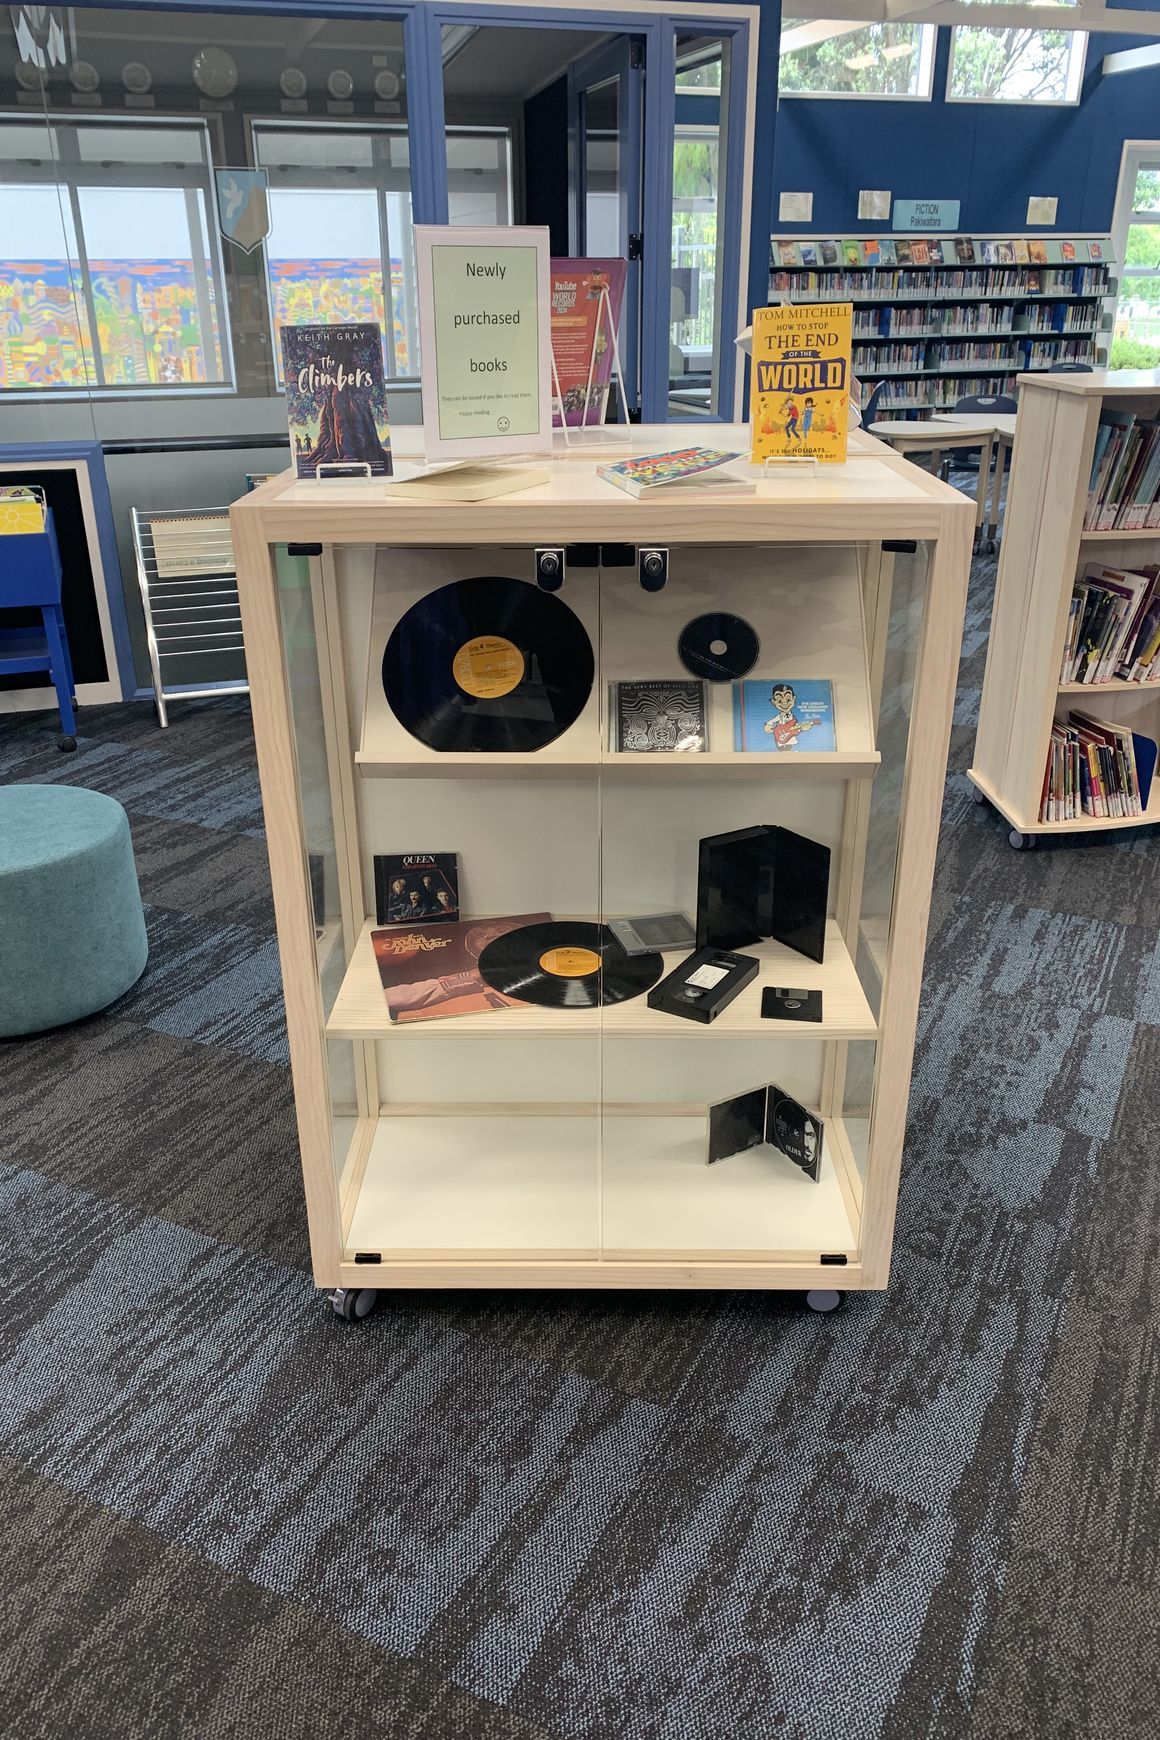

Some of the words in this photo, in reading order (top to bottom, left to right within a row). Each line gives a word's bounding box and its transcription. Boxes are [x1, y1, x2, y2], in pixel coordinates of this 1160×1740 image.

[915, 203, 939, 215] FICTION
[466, 262, 507, 280] Newly
[554, 280, 577, 291] YouTube
[552, 291, 577, 301] WORLD
[454, 309, 521, 329] purchased
[758, 310, 784, 321] TOM
[788, 307, 850, 319] MITCHELL
[776, 324, 794, 332] HOW
[797, 323, 807, 331] TO
[808, 322, 829, 331] STOP
[297, 333, 330, 342] KEITH
[336, 332, 366, 341] GRAY
[764, 334, 801, 350] THE
[805, 333, 839, 347] END
[320, 355, 336, 369] The
[470, 357, 508, 373] books
[298, 363, 374, 394] Climbers
[760, 362, 842, 390] WORLD
[402, 855, 436, 866] QUEEN
